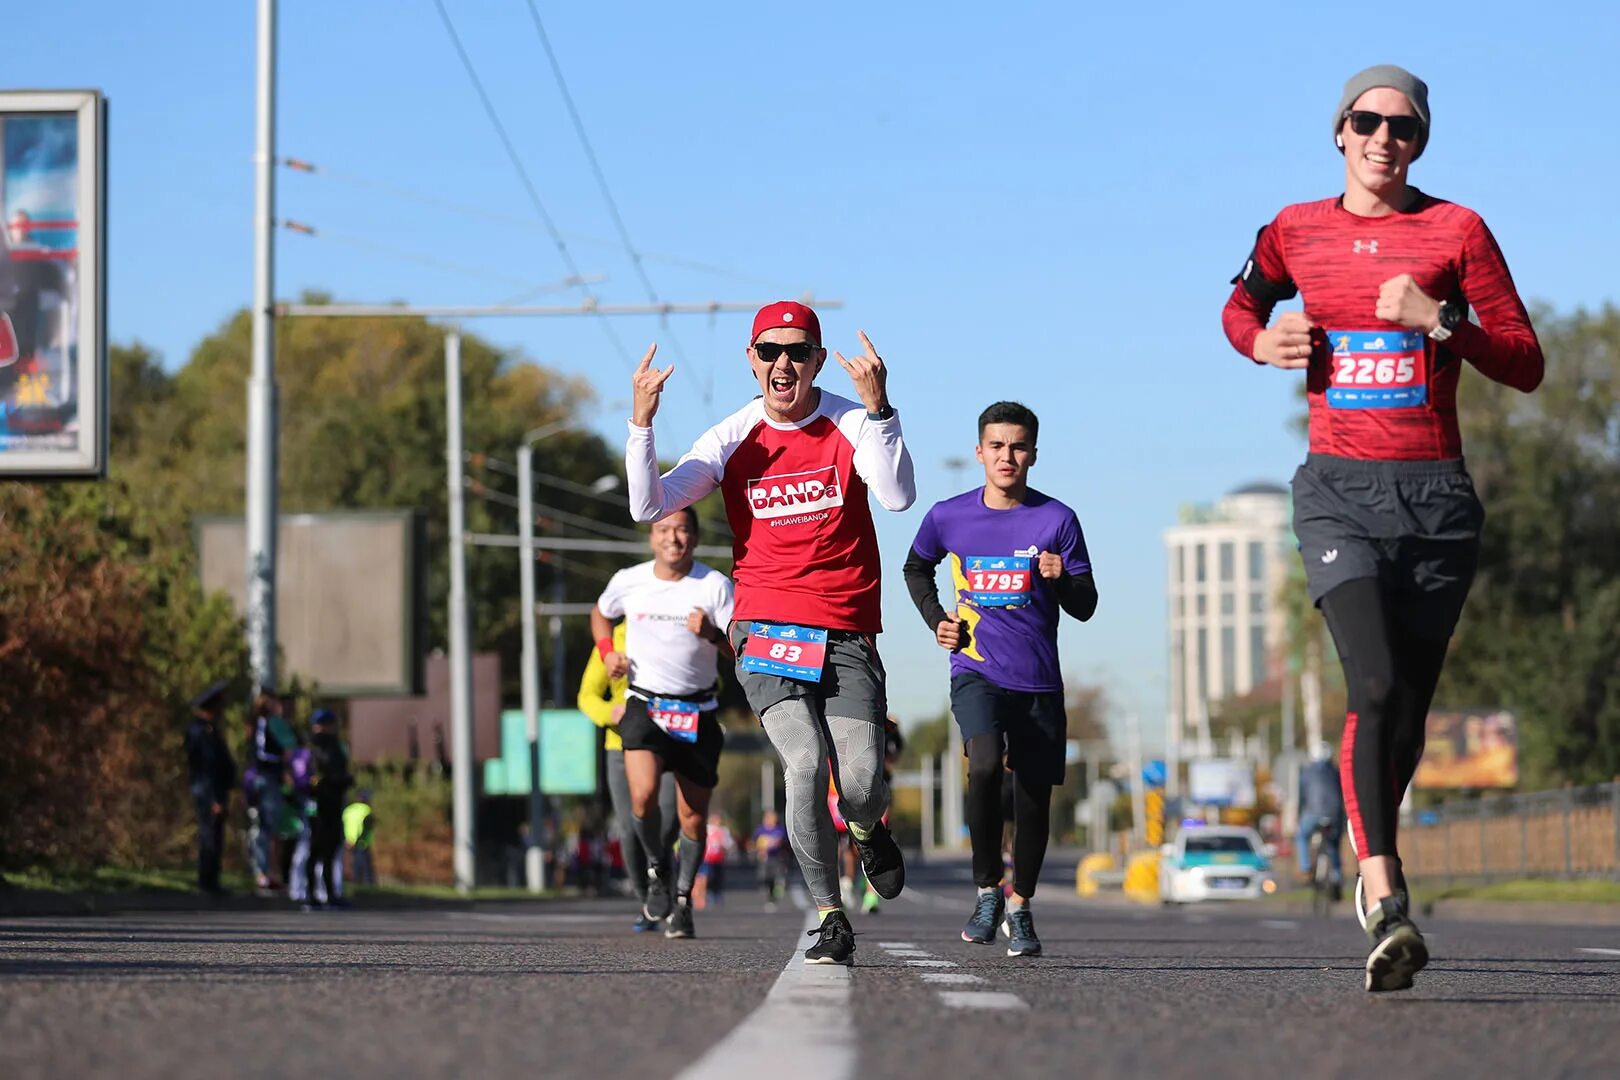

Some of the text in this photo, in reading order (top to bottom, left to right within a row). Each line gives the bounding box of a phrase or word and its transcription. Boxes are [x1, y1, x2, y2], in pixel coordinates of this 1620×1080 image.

[1336, 357, 1415, 384] 2265
[973, 573, 1024, 590] 1795
[769, 643, 803, 663] 83
